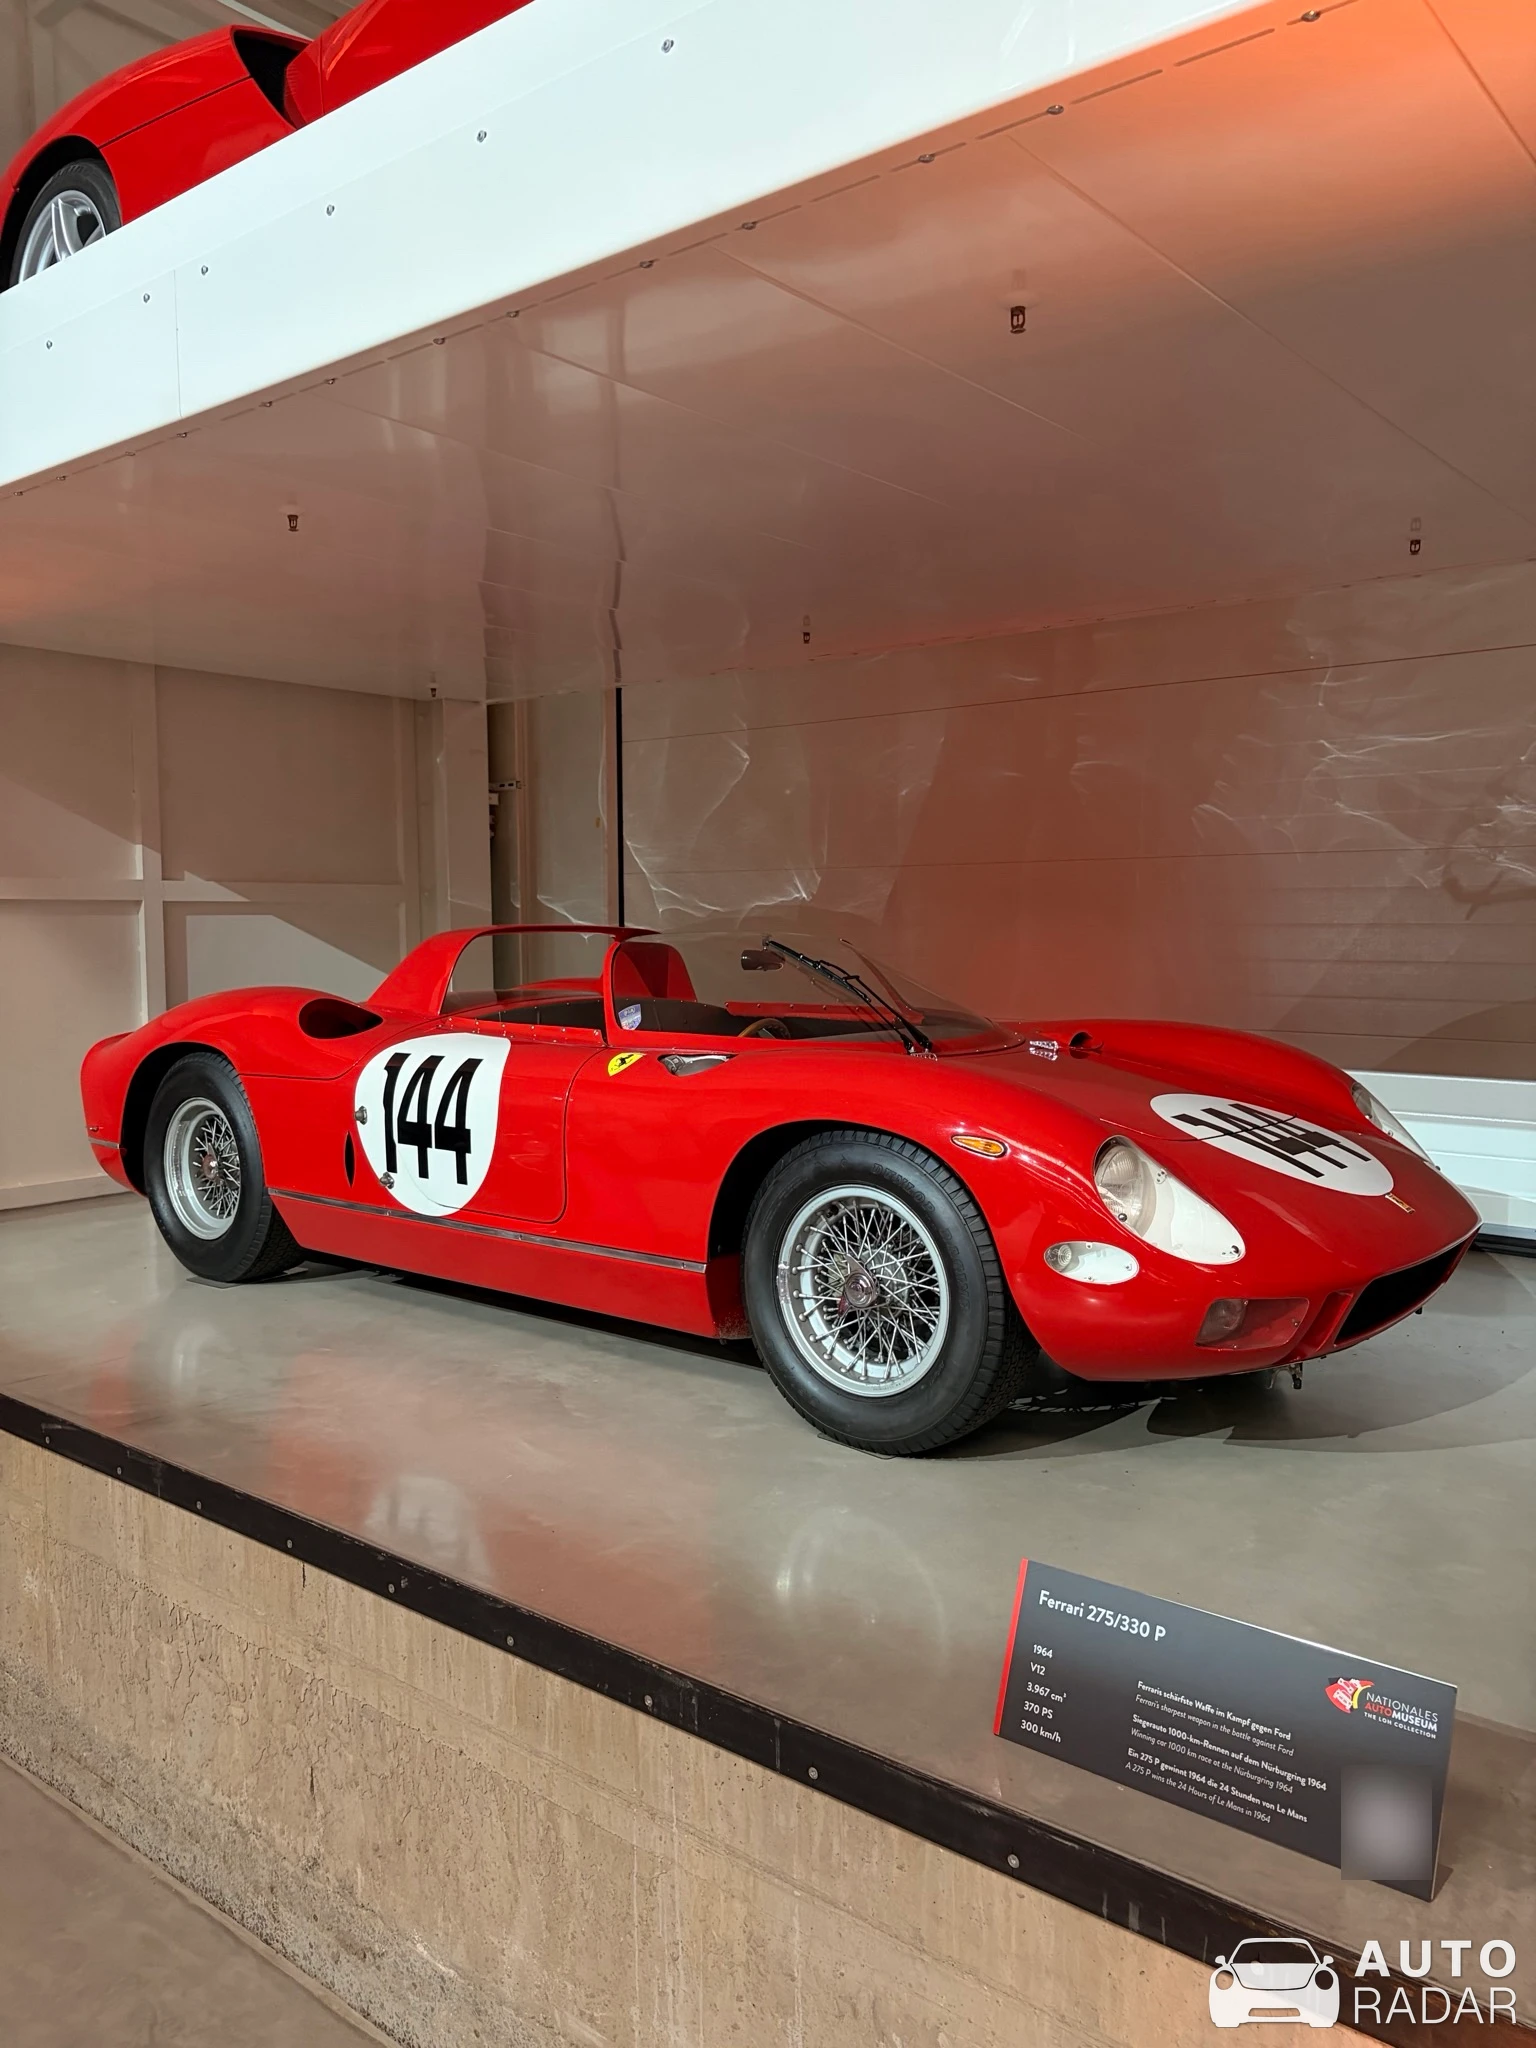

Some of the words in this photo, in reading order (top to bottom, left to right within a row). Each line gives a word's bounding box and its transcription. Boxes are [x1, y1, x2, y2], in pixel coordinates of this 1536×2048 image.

[383, 1052, 484, 1185] 144
[1170, 1103, 1371, 1178] 144
[871, 1162, 936, 1213] DUNLOP
[1038, 1589, 1084, 1617] Ferrari
[1086, 1605, 1151, 1638] 275/330
[1154, 1625, 1167, 1641] P
[1030, 1661, 1046, 1676] V12
[1033, 1644, 1053, 1658] 1964
[1023, 1700, 1040, 1714] 370
[1041, 1706, 1054, 1719] PS
[1026, 1681, 1051, 1697] 3.967
[1137, 1680, 1162, 1696] Ferraris
[1163, 1691, 1194, 1707] schärfste
[1194, 1699, 1215, 1715] Waffe
[1215, 1707, 1225, 1718] im
[1226, 1710, 1251, 1728] Kampf
[1250, 1722, 1273, 1735] gegen
[1273, 1727, 1292, 1741] Ford
[1366, 1691, 1438, 1723] NATIONALES
[1020, 1719, 1039, 1734] 300
[1039, 1726, 1062, 1743] km/h
[1160, 1703, 1187, 1719] sharpest
[1187, 1713, 1211, 1727] weapon
[1211, 1720, 1219, 1730] in
[1219, 1724, 1231, 1735] the
[1231, 1727, 1251, 1742] battle
[1251, 1736, 1276, 1751] against
[1277, 1743, 1295, 1757] Ford
[1363, 1711, 1377, 1721] THE
[1393, 1721, 1437, 1740] COLLECTION
[1364, 1702, 1438, 1733] AUTOMUSEUM
[1131, 1727, 1156, 1746] Winning
[1156, 1738, 1167, 1748] car
[1168, 1741, 1186, 1755] 1000
[1186, 1748, 1197, 1759] km
[1197, 1754, 1212, 1765] race
[1212, 1759, 1220, 1768] at
[1221, 1761, 1233, 1772] the
[1233, 1765, 1274, 1789] Nürburgring
[1275, 1780, 1294, 1794] 1964
[1132, 1713, 1167, 1733] Siegerauto
[1168, 1726, 1230, 1757] 1000-km-Rennen
[1230, 1752, 1244, 1761] auf
[1243, 1755, 1260, 1767] dem
[1261, 1760, 1306, 1787] Nürburgring
[1307, 1777, 1327, 1791] 1964
[1124, 1761, 1131, 1770] A
[1131, 1763, 1145, 1775] 275
[1145, 1768, 1152, 1777] P
[1151, 1772, 1165, 1783] wins
[1165, 1777, 1177, 1788] the
[1177, 1781, 1187, 1791] 24
[1187, 1784, 1207, 1799] Hours
[1208, 1794, 1217, 1805] of
[1216, 1796, 1225, 1806] Le
[1225, 1800, 1244, 1814] Mans
[1245, 1806, 1252, 1817] in
[1253, 1810, 1271, 1824] 1964
[1127, 1747, 1139, 1759] Ein
[1139, 1752, 1153, 1764] 275
[1154, 1757, 1160, 1766] P
[1160, 1762, 1187, 1777] gewinnt
[1188, 1770, 1206, 1784] 1964
[1206, 1777, 1218, 1789] die
[1219, 1782, 1229, 1793] 24
[1230, 1786, 1261, 1805] Stunden
[1261, 1799, 1275, 1811] von
[1276, 1803, 1286, 1814] Le
[1286, 1807, 1308, 1823] Mans
